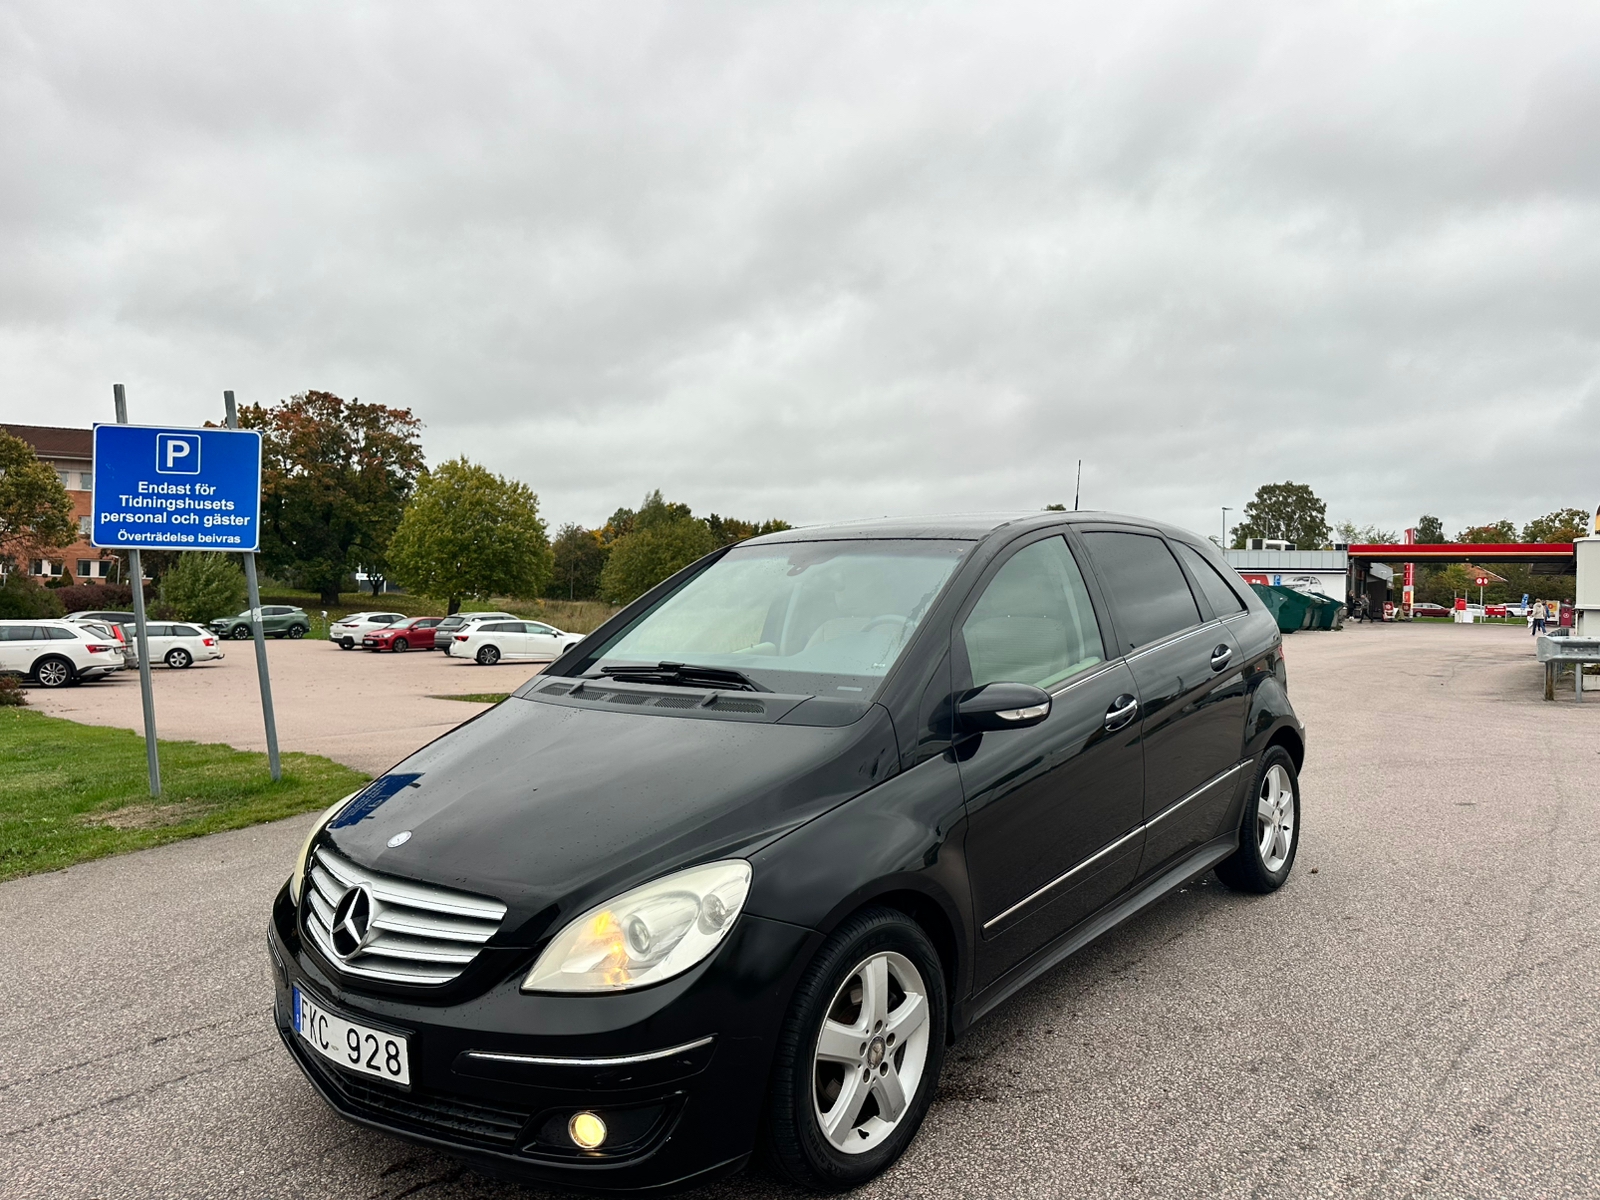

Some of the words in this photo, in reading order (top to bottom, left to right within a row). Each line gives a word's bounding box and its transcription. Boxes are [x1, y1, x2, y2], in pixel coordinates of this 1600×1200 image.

[166, 440, 190, 468] P
[138, 481, 191, 495] Endast
[194, 483, 216, 496] för
[119, 495, 235, 511] Tidningshusets
[101, 511, 167, 524] personal
[171, 513, 199, 525] och
[203, 514, 250, 528] gäster
[117, 529, 194, 543] Överträdelse
[198, 532, 241, 544] beivras
[301, 997, 329, 1050] FKC
[346, 1028, 401, 1076] 928
